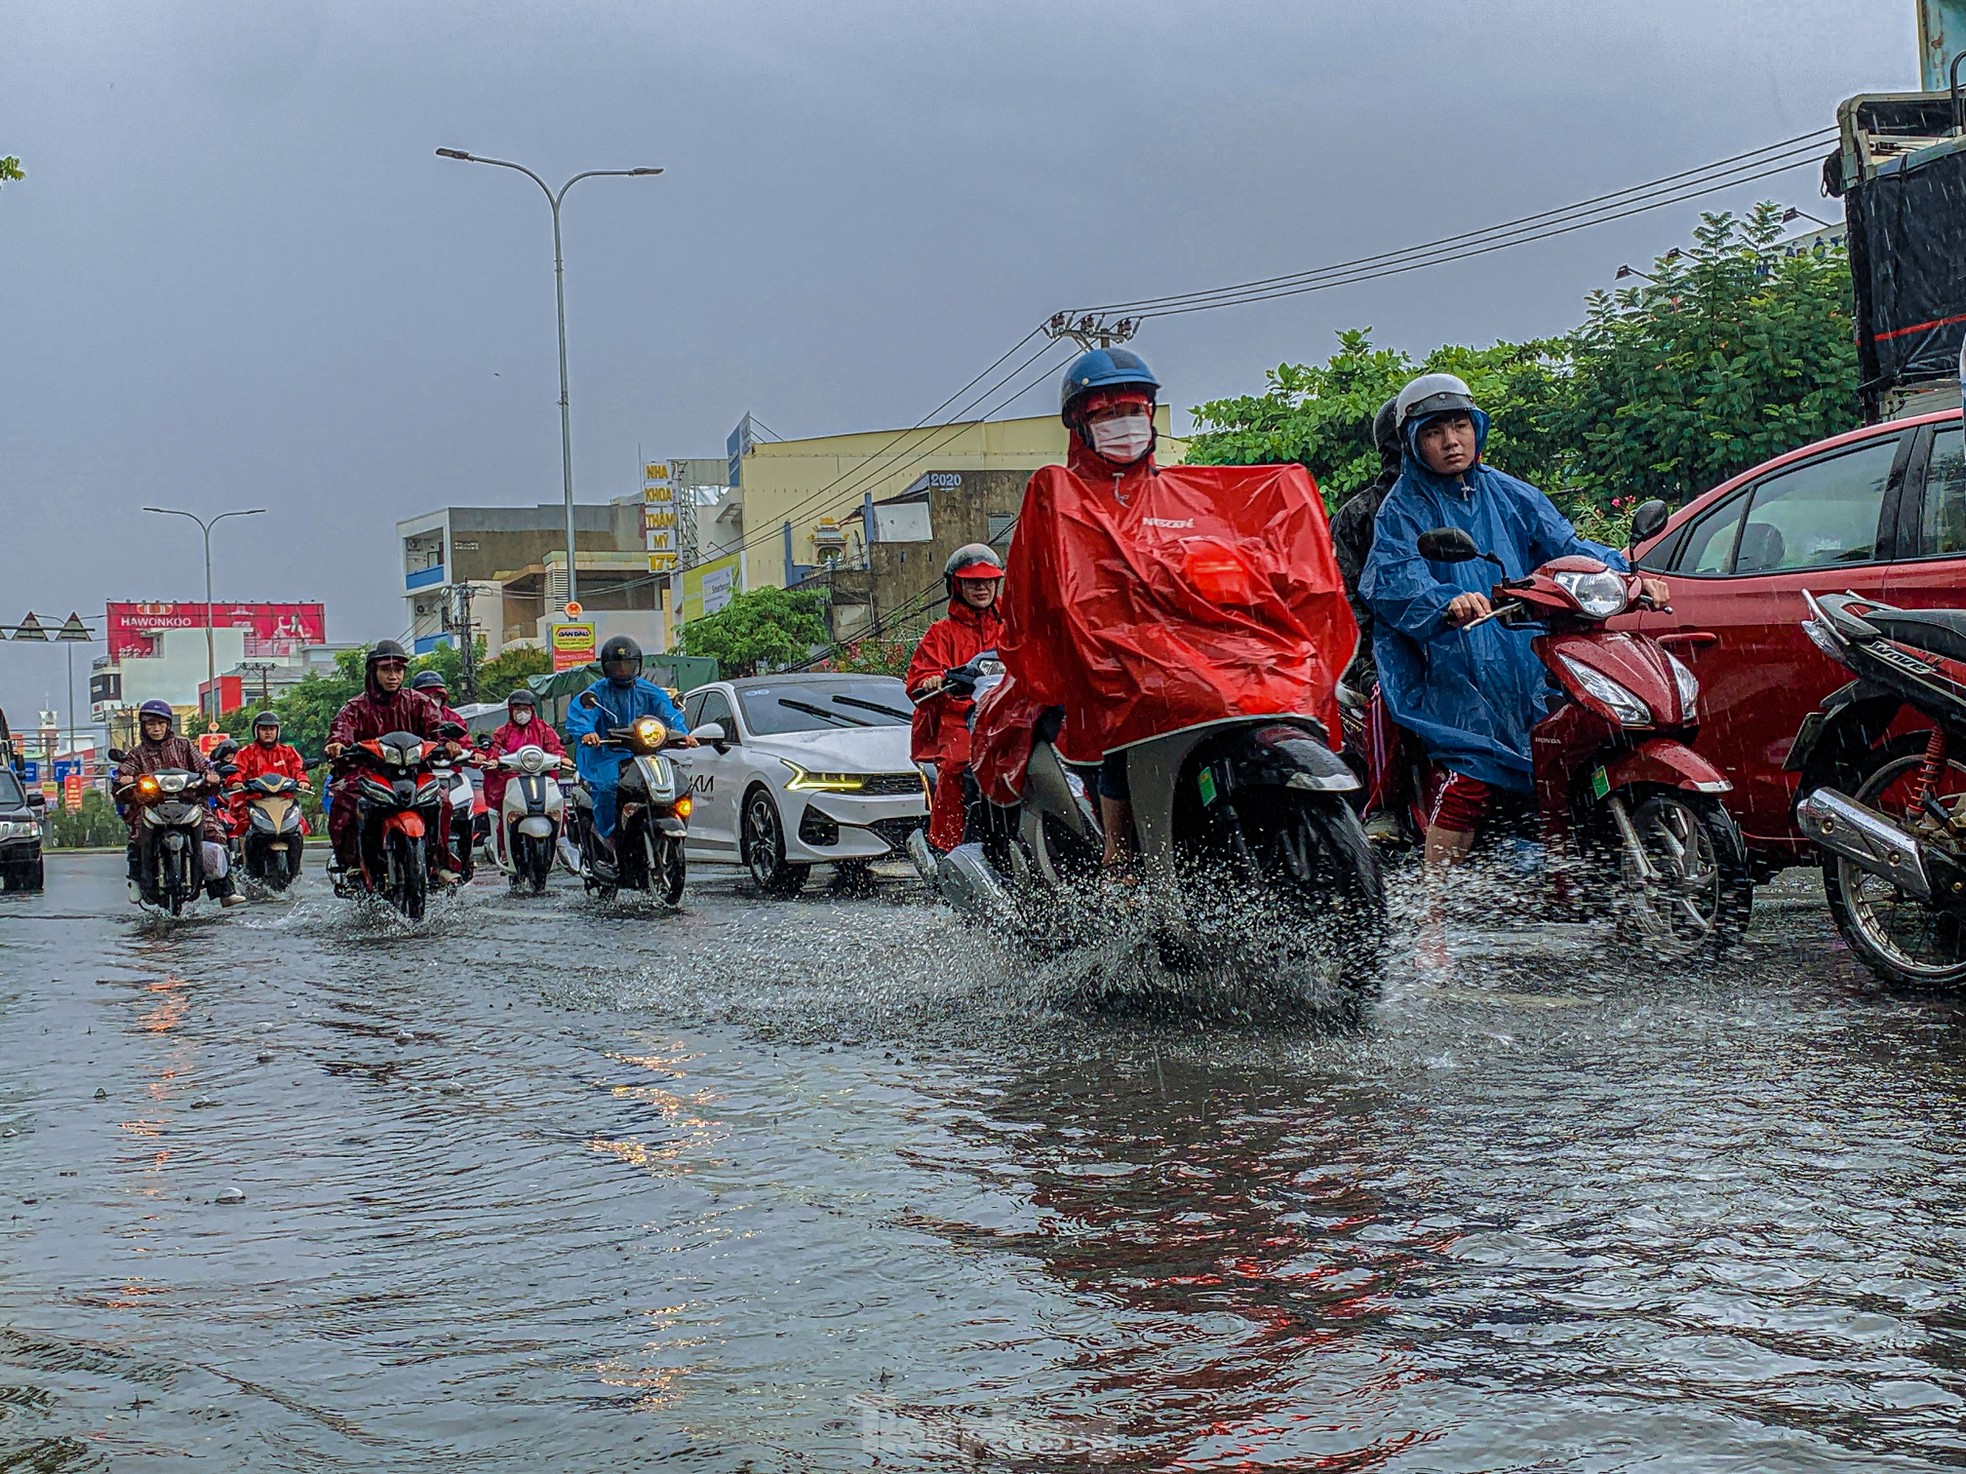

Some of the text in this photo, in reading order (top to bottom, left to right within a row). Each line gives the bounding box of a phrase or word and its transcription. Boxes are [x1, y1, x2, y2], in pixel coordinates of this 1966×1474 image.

[646, 464, 668, 479] NHA
[930, 473, 962, 487] 2020
[645, 487, 673, 502] KHOA
[121, 617, 192, 627] HAWONKOO
[1535, 736, 1562, 744] HONDA
